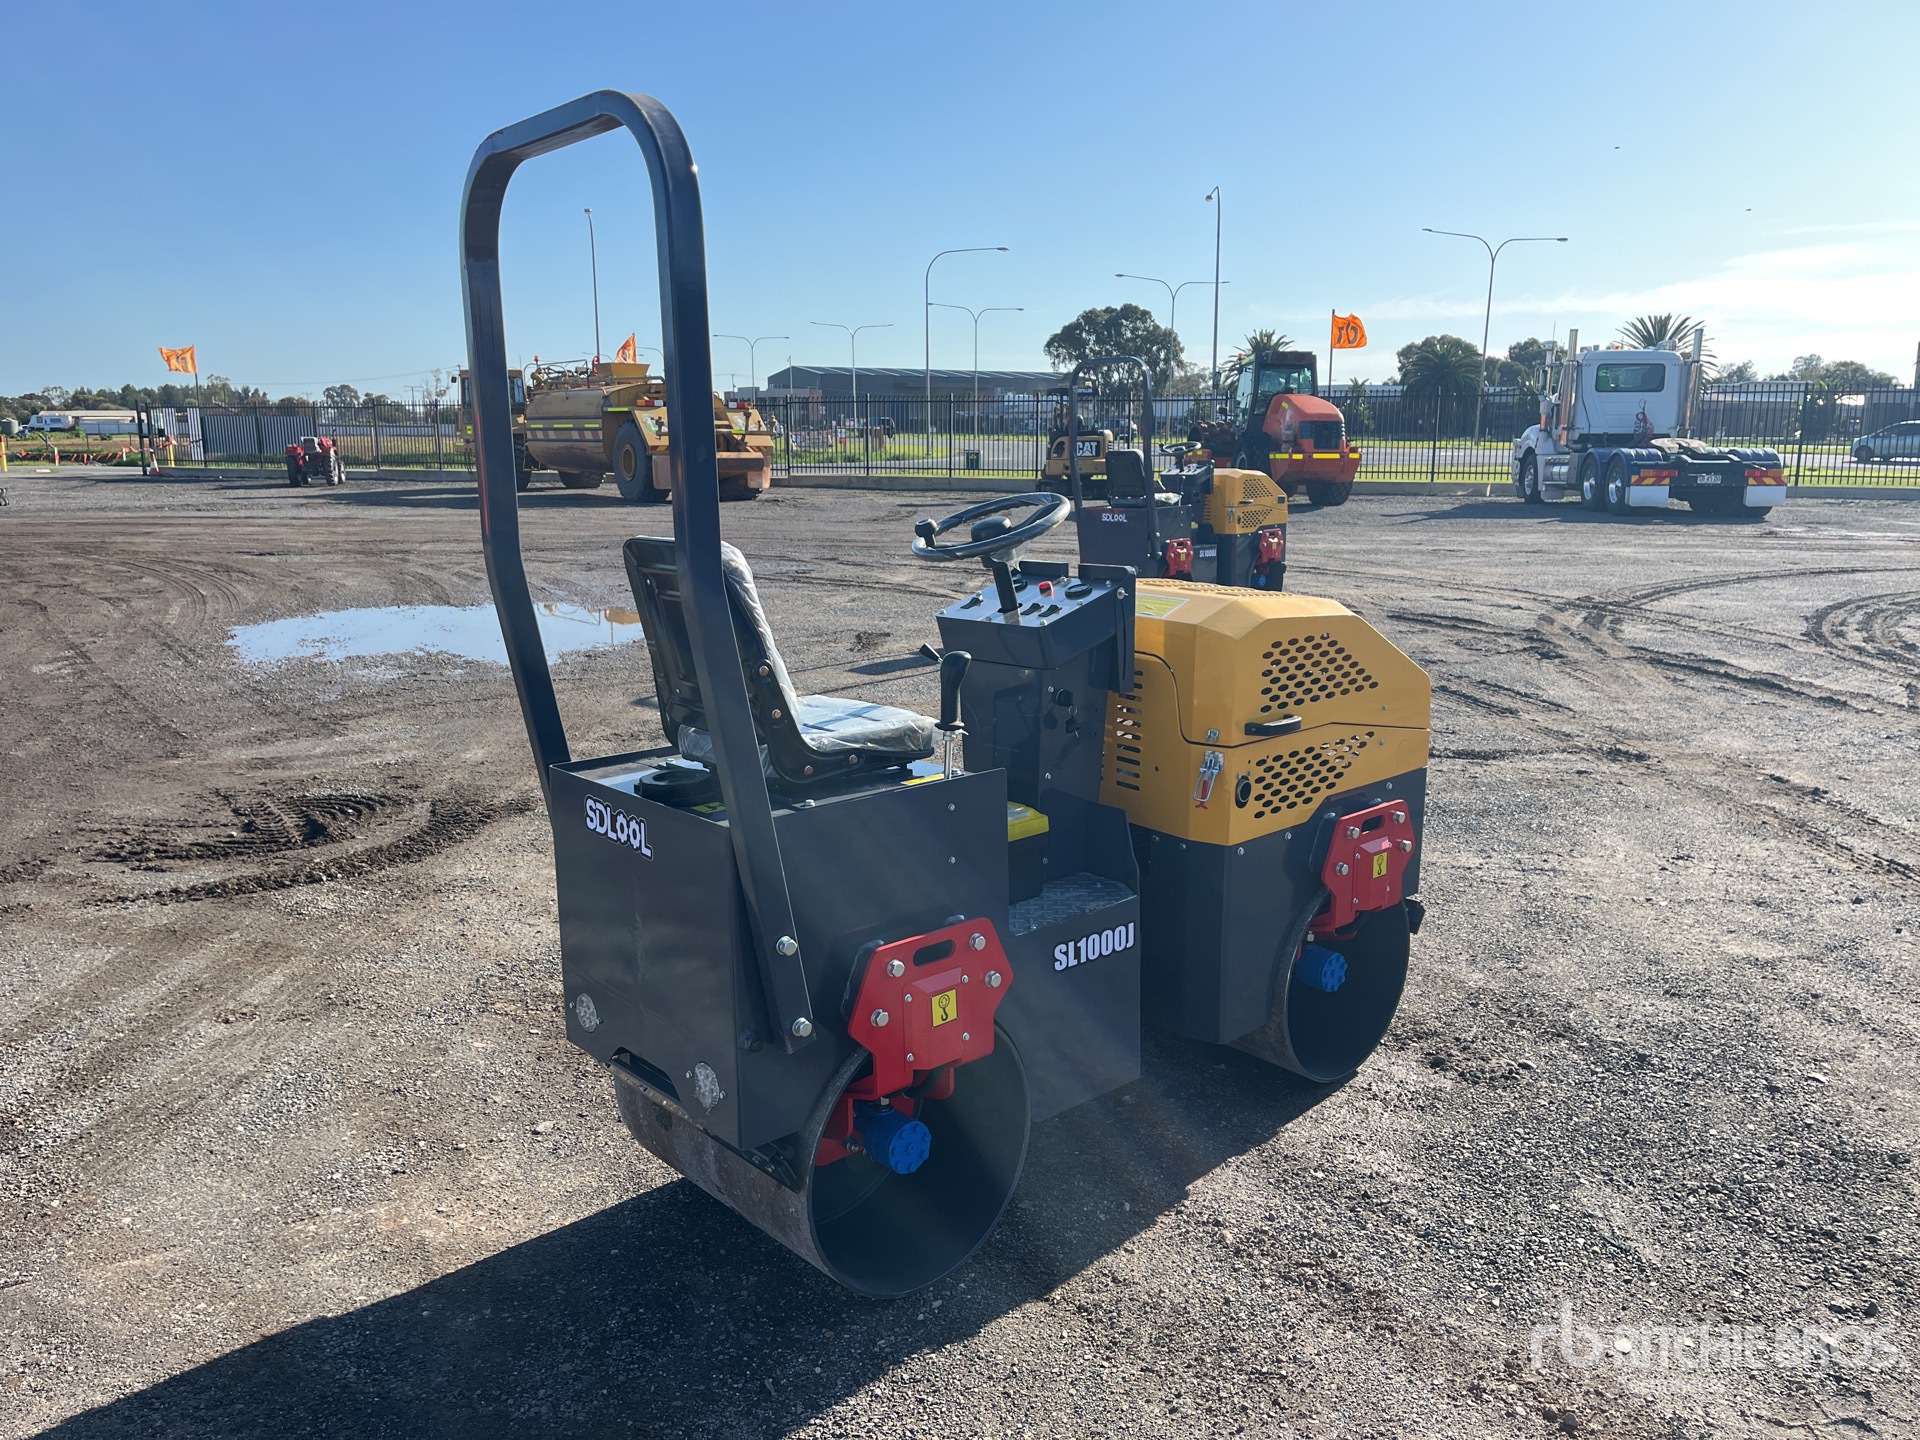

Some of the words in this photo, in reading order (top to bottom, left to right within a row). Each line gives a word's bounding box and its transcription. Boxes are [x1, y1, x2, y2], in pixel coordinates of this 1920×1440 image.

[1076, 441, 1098, 457] CAT
[586, 798, 652, 857] SDLOOL
[1054, 922, 1135, 971] SL1000J
